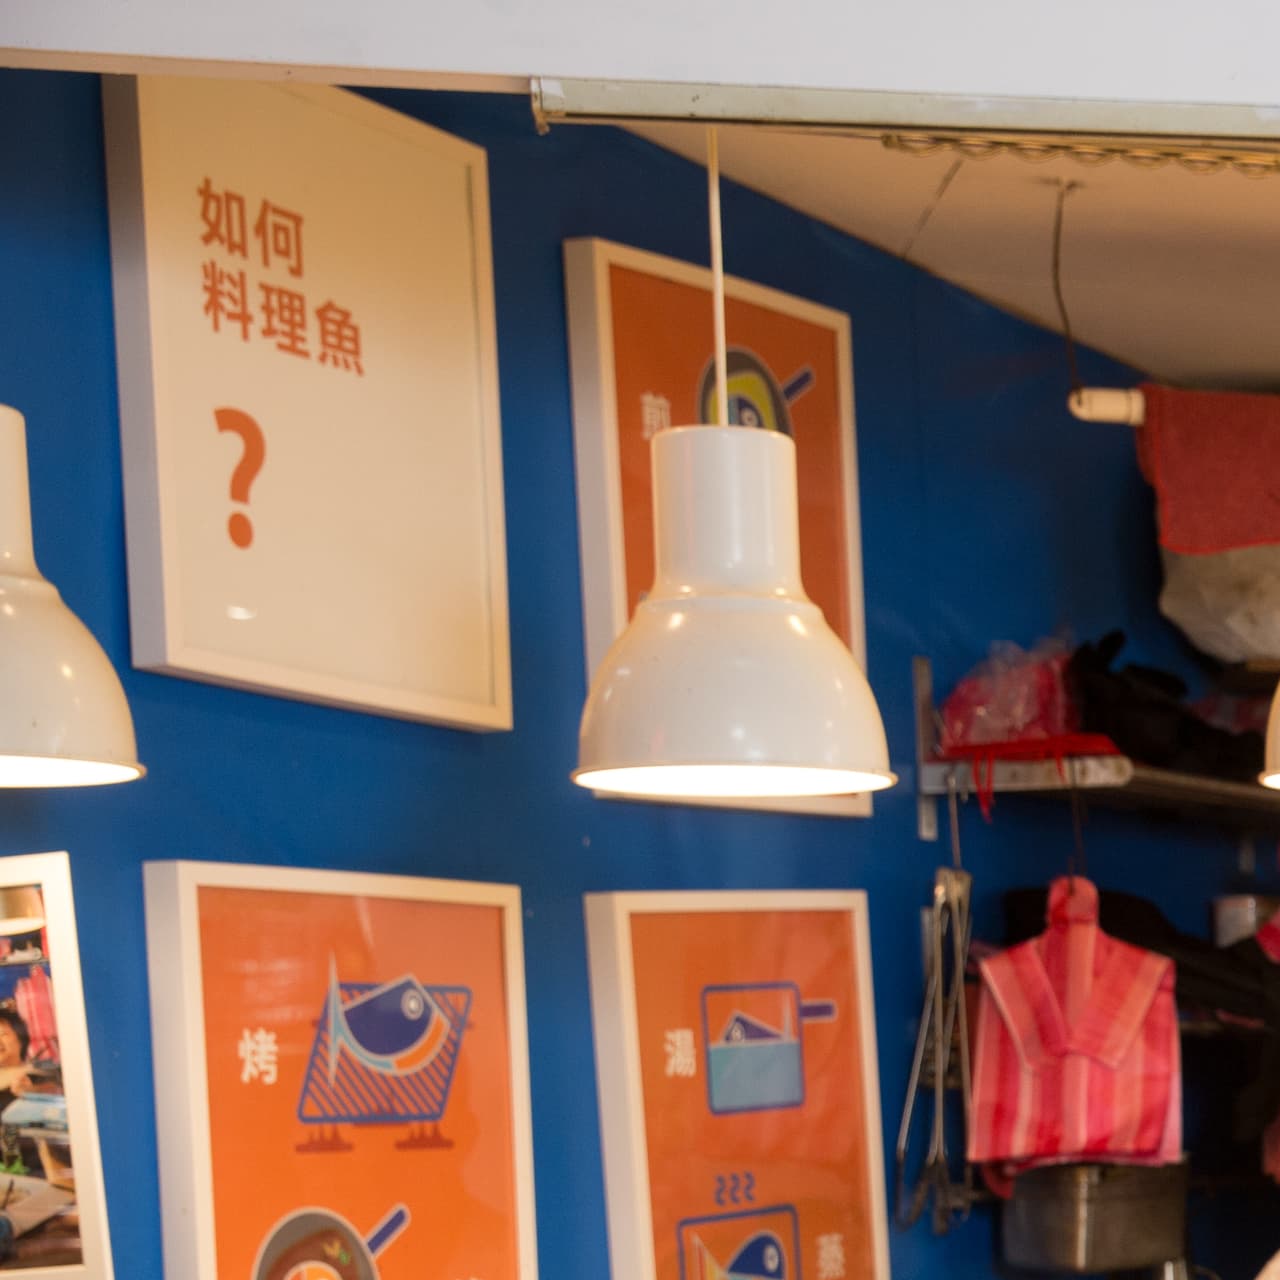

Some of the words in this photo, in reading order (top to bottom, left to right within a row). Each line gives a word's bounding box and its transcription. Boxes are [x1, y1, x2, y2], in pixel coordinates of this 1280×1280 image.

[197, 176, 304, 279] 如何
[202, 260, 364, 377] 料理魚
[238, 1027, 279, 1085] 烤
